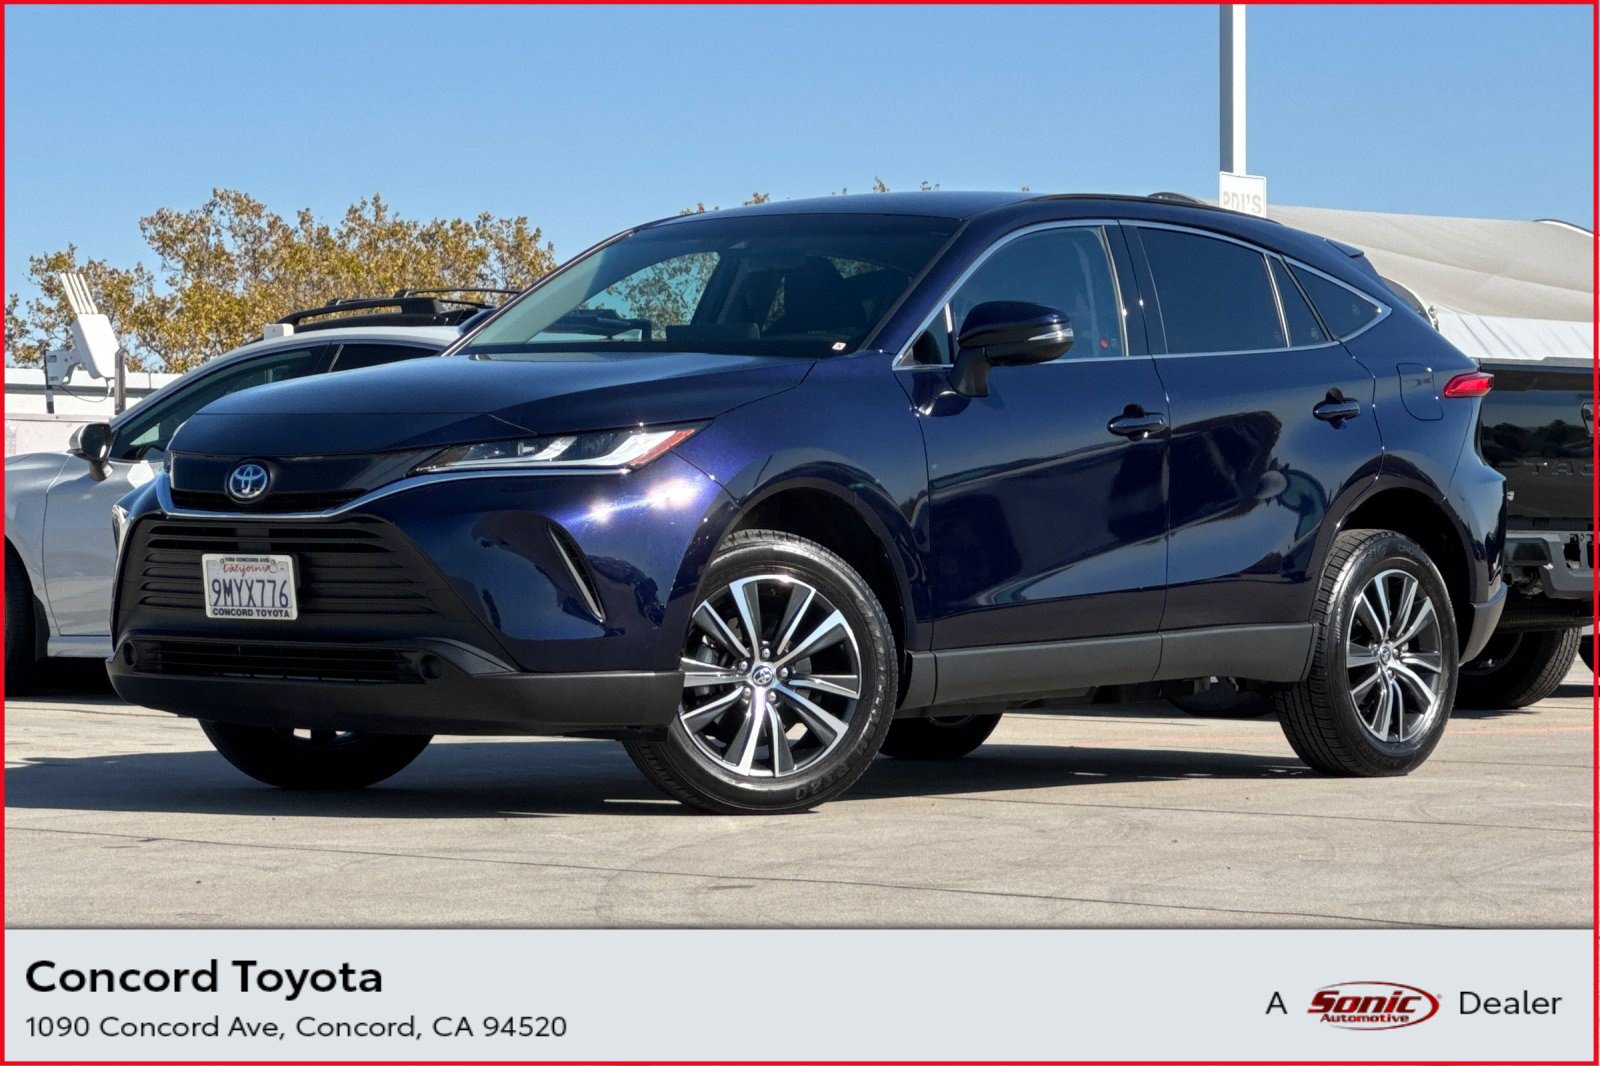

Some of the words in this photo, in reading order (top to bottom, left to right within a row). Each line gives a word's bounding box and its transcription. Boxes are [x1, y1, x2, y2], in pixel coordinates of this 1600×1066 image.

[211, 578, 289, 607] 9MYX776
[212, 608, 254, 616] CONCORD
[255, 608, 290, 618] TOYOTA
